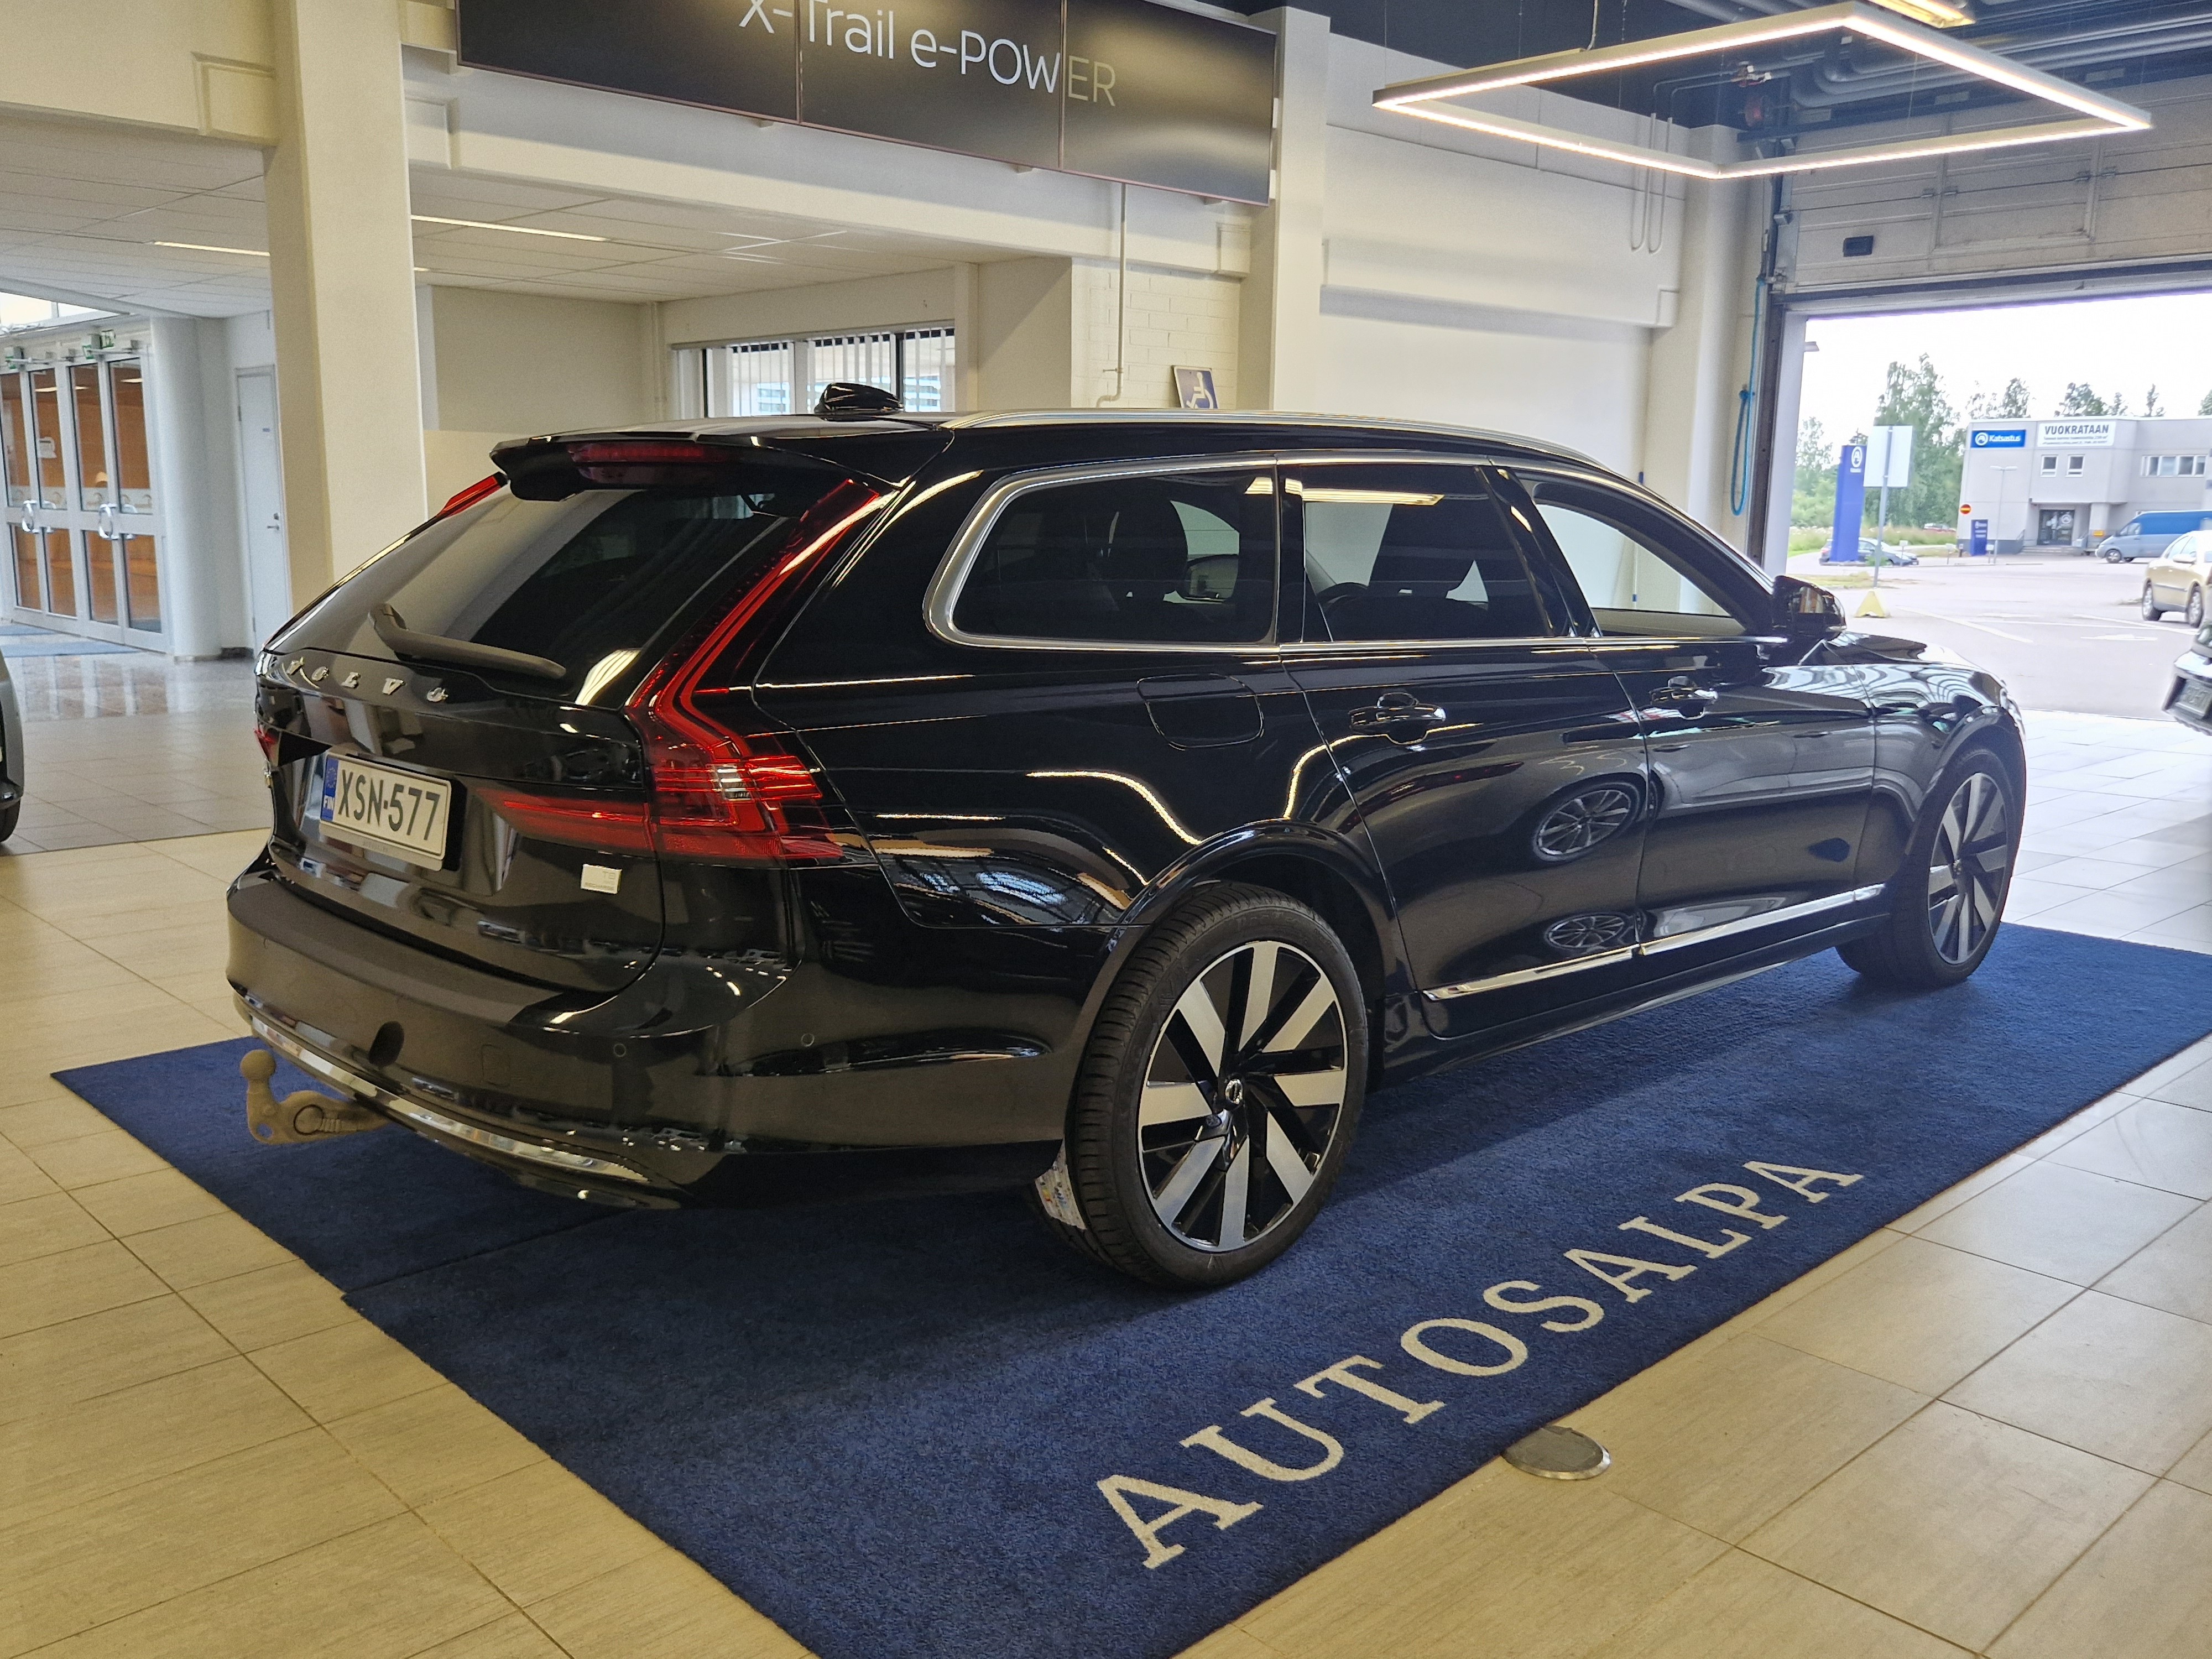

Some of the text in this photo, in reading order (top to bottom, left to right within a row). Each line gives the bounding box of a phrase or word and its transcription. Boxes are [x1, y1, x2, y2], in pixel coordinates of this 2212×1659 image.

[739, 0, 1115, 106] X-Trail e-POWER
[2044, 424, 2109, 435] VUOKRATAAN
[286, 656, 449, 703] VOLVO
[323, 795, 336, 811] FIN
[338, 769, 441, 841] XSN-577
[1096, 1160, 1865, 1569] AUTOSALPA
